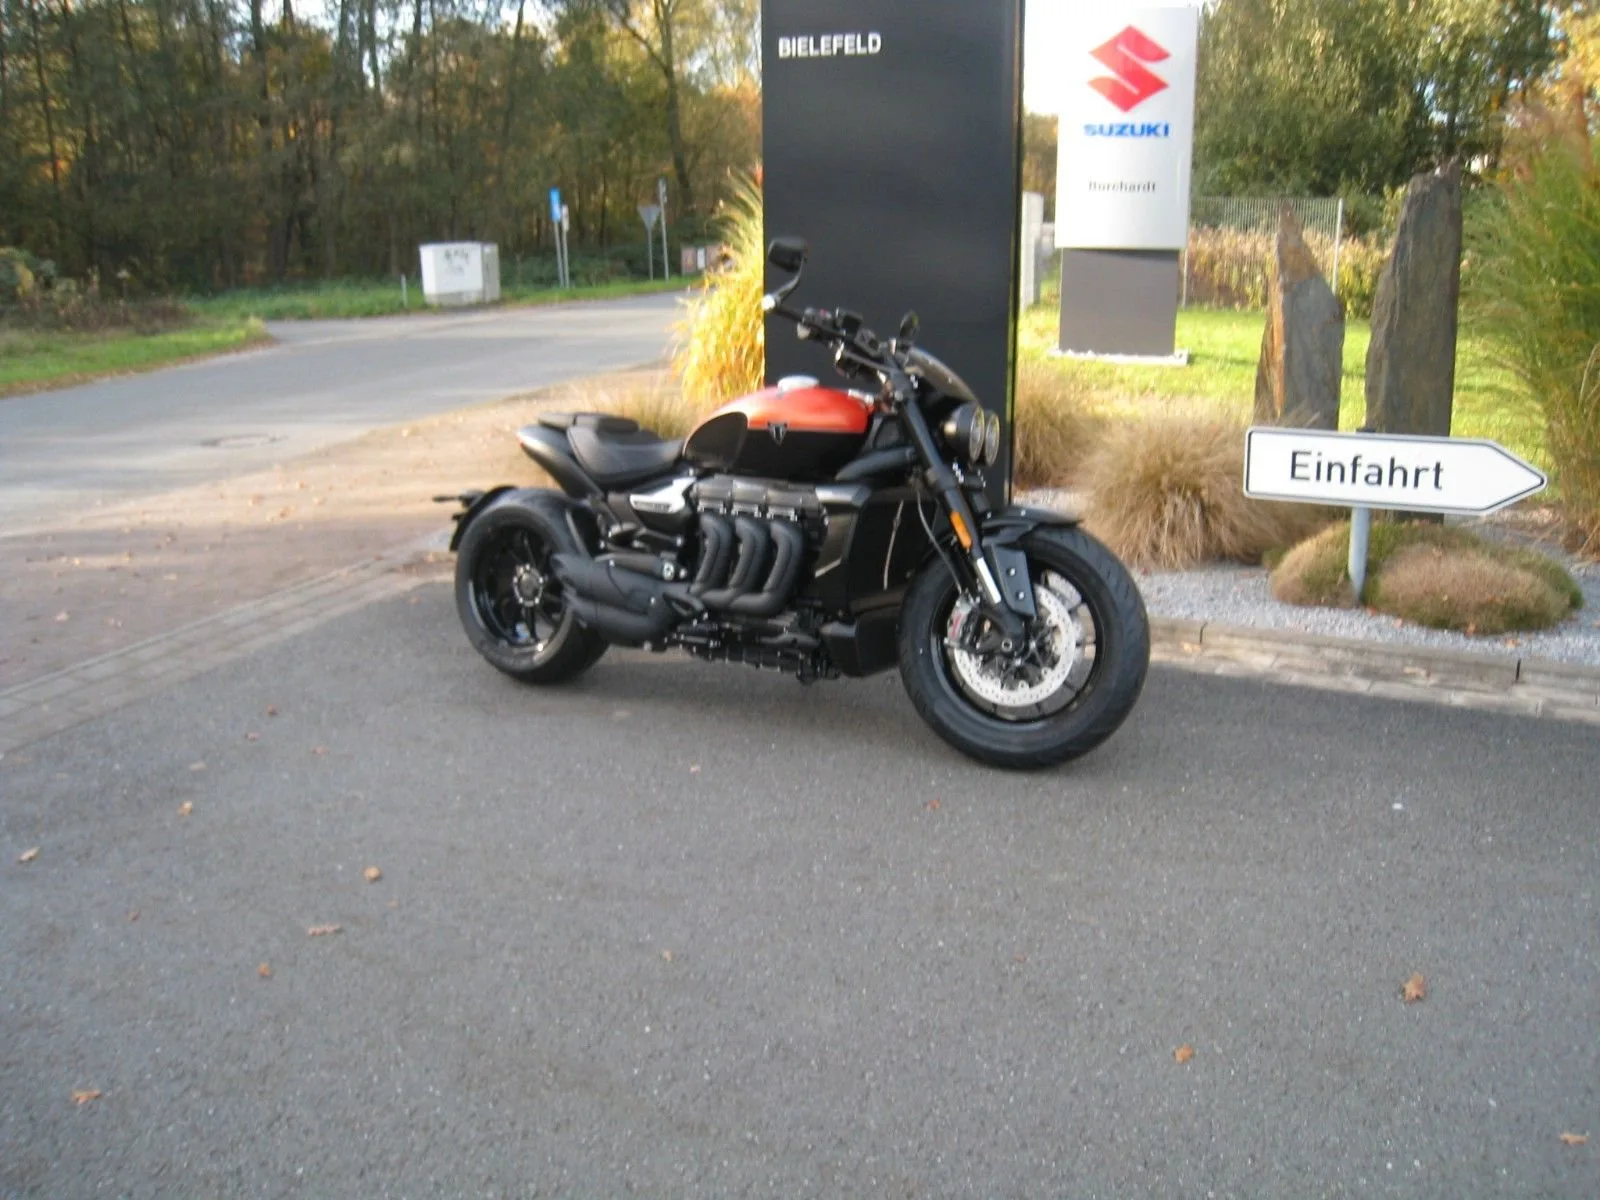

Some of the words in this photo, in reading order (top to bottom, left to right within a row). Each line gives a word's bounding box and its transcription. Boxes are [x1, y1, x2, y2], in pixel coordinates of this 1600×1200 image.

[778, 32, 882, 59] BIELEFELD
[1083, 122, 1170, 138] SUZUKI
[1290, 449, 1444, 490] Einfahrt
